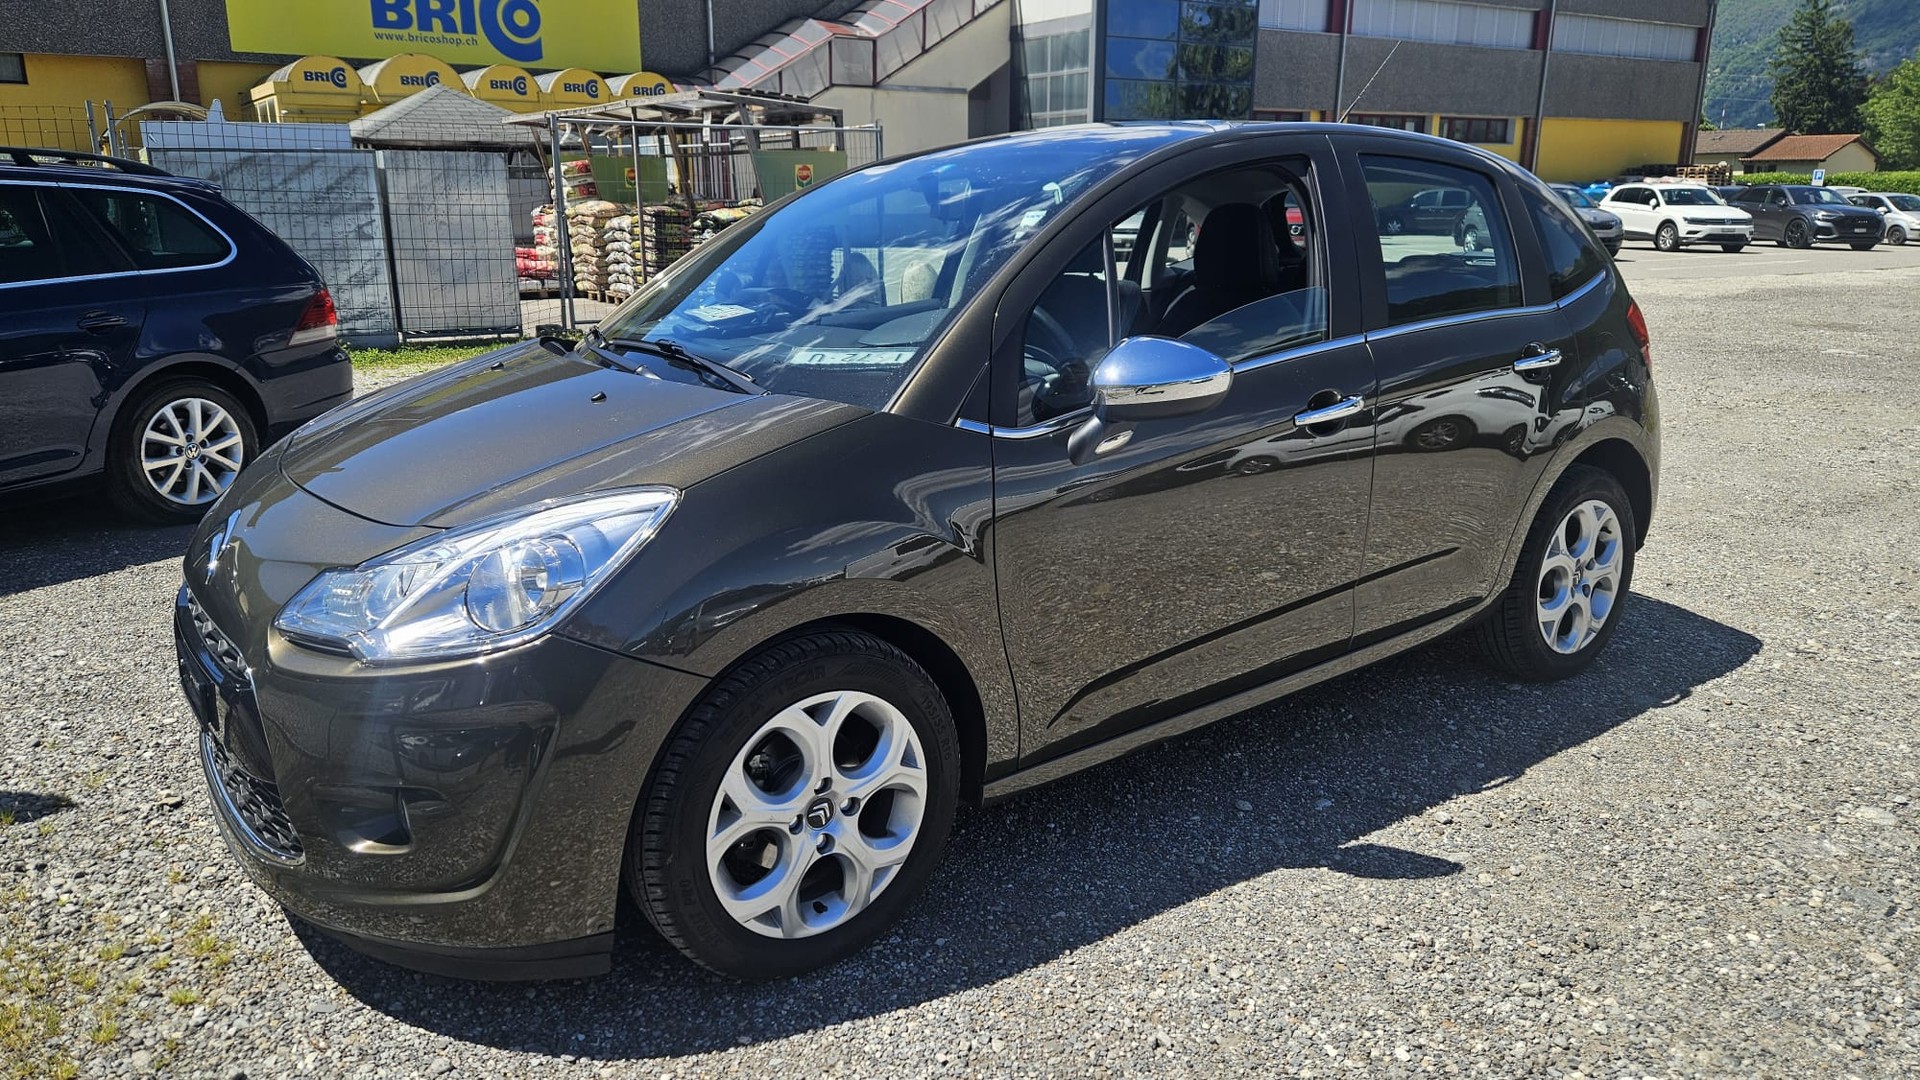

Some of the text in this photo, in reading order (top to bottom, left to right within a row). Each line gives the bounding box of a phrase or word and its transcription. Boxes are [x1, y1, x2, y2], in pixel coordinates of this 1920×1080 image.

[374, 31, 478, 46] www.bricoshop.ch
[303, 67, 347, 88] BRICO
[400, 71, 440, 88] BRICO
[490, 76, 527, 96] BRICO
[563, 79, 599, 98] BRICO
[633, 83, 666, 96] BRICO
